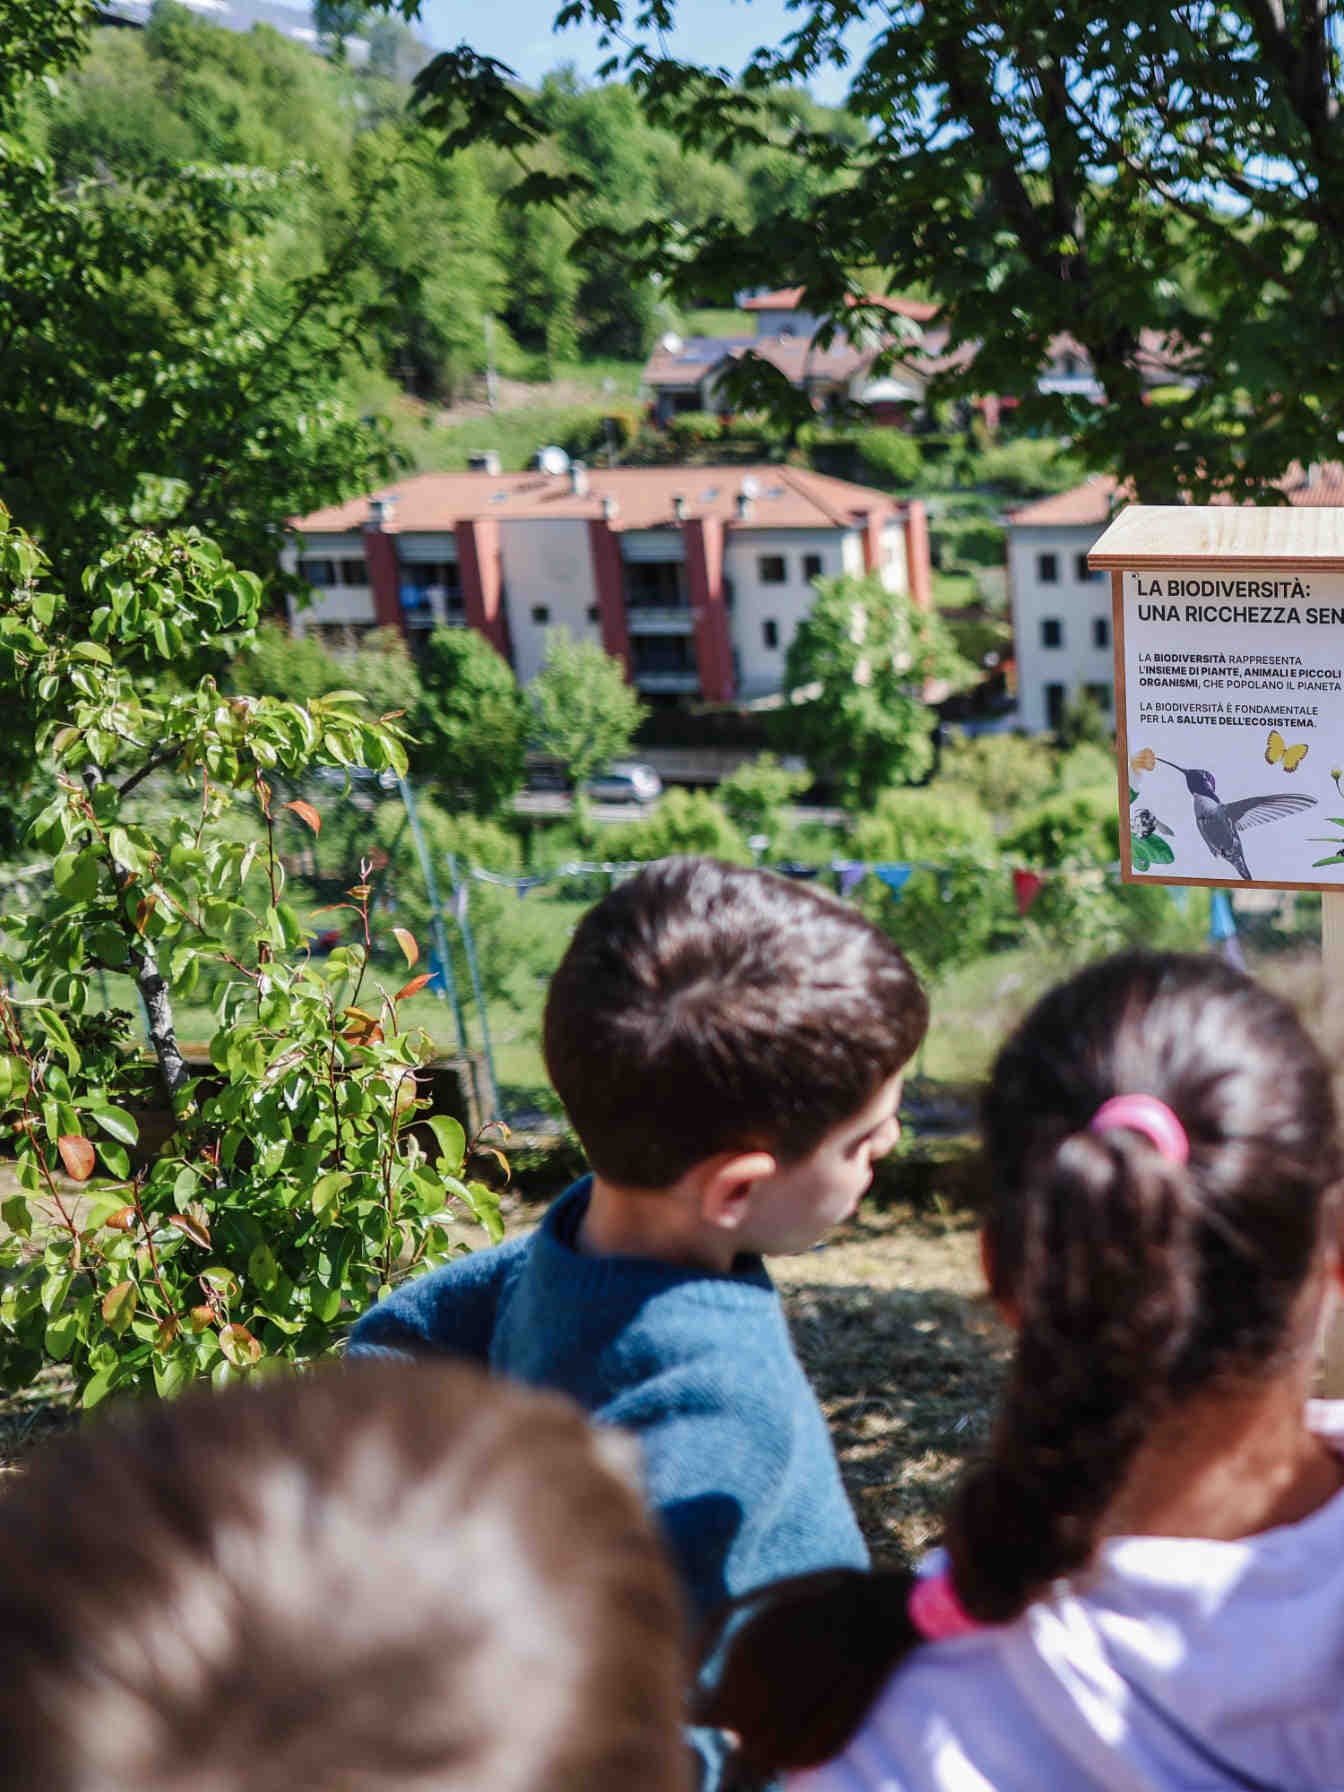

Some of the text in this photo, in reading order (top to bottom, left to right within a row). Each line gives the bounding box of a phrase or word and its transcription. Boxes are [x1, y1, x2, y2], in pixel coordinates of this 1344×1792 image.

[1137, 577, 1311, 599] LA BIODIVERSITÀ:
[1138, 605, 1180, 622] UNA
[1186, 606, 1301, 624] RICCHEZZA
[1139, 652, 1302, 665] LA BIODIVERSITÀ RAPPRESENTA
[1139, 665, 1342, 679] L'INSIEME DI PIANTE, ANIMALI E PICCOLI
[1139, 678, 1201, 689] ORGANISMI,
[1203, 679, 1224, 688] CHE
[1226, 680, 1284, 690] POPOLANO
[1286, 681, 1295, 690] IL
[1297, 681, 1341, 691] PIANETA
[1140, 701, 1319, 715] LA BIODIVERSITÀ È FONDAMENTALE
[1140, 714, 1317, 728] PER LA SALUTE DELL'ECOSISTEMA.
